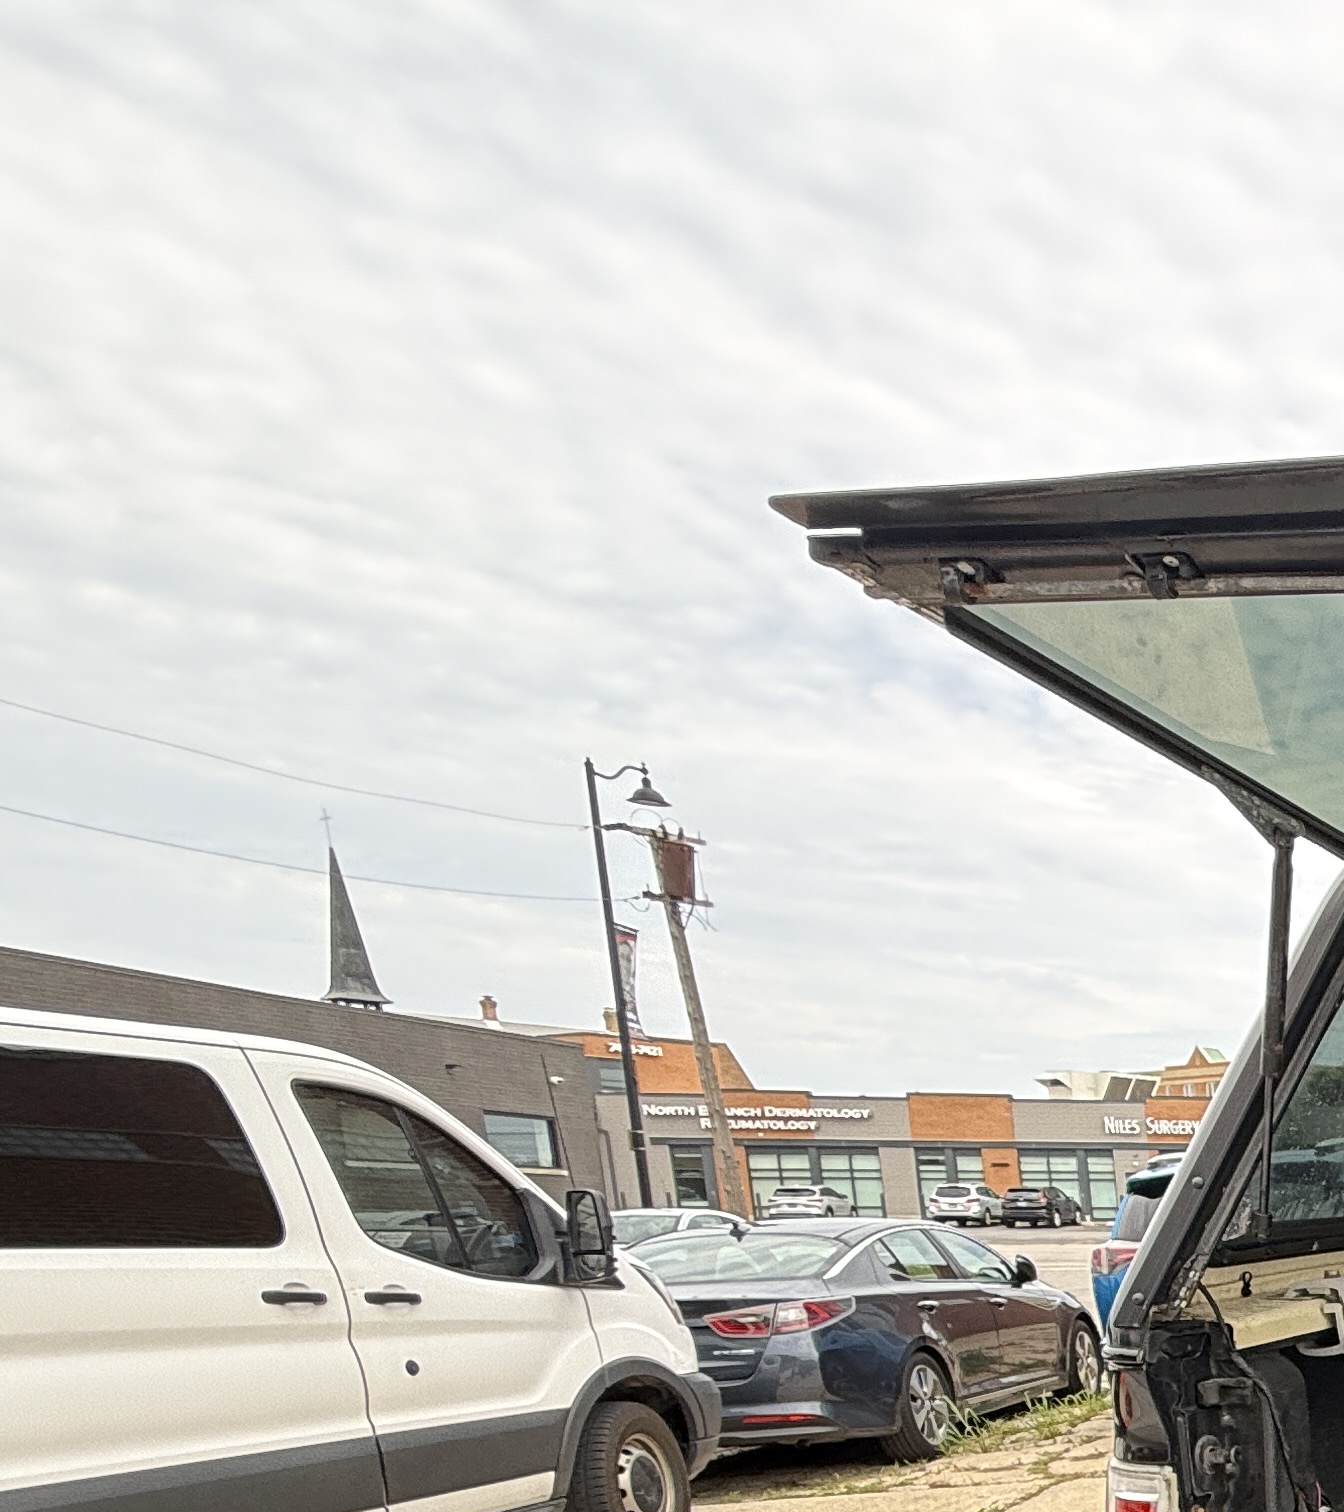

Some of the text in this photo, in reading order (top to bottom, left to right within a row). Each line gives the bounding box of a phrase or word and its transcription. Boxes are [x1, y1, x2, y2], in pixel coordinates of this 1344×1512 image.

[641, 1104, 871, 1119] NORTH BNCH DERMATOLOGY
[699, 1117, 818, 1130] RUMATOLOGY
[1103, 1116, 1200, 1135] NILES SURGERY
